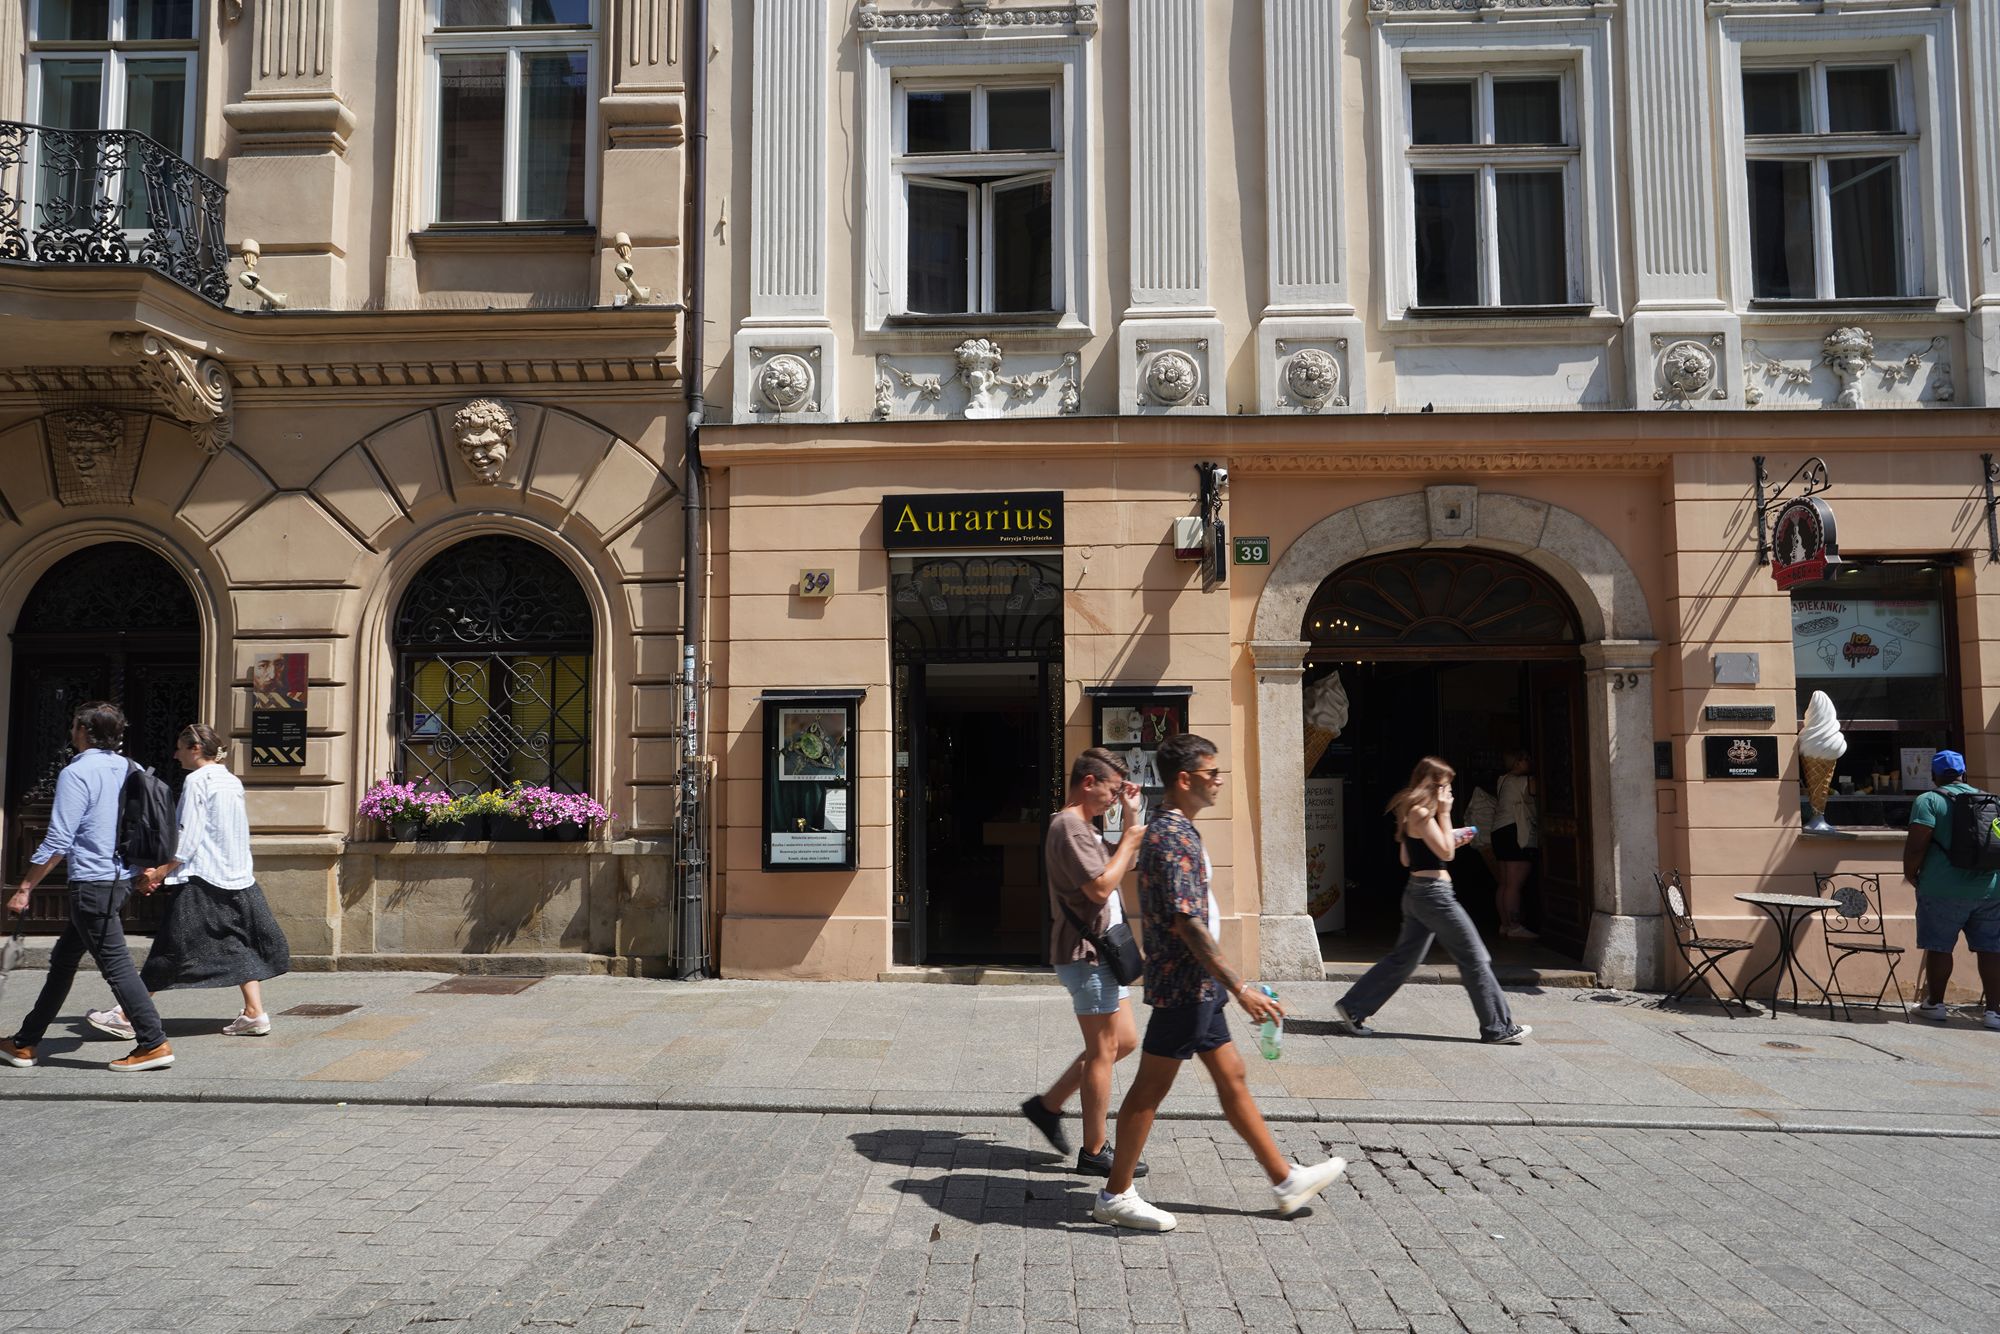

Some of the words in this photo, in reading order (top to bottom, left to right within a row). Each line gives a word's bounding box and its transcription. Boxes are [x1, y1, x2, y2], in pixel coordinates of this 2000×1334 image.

[893, 499, 1054, 533] Aurarius
[1241, 546, 1263, 561] 39
[922, 564, 960, 578] Salon
[803, 571, 830, 594] 39
[941, 583, 1013, 596] Pracownia
[1793, 600, 1842, 614] APIEKANKI
[1849, 632, 1872, 645] Ice
[1843, 643, 1879, 657] Cream
[1613, 673, 1639, 690] 39
